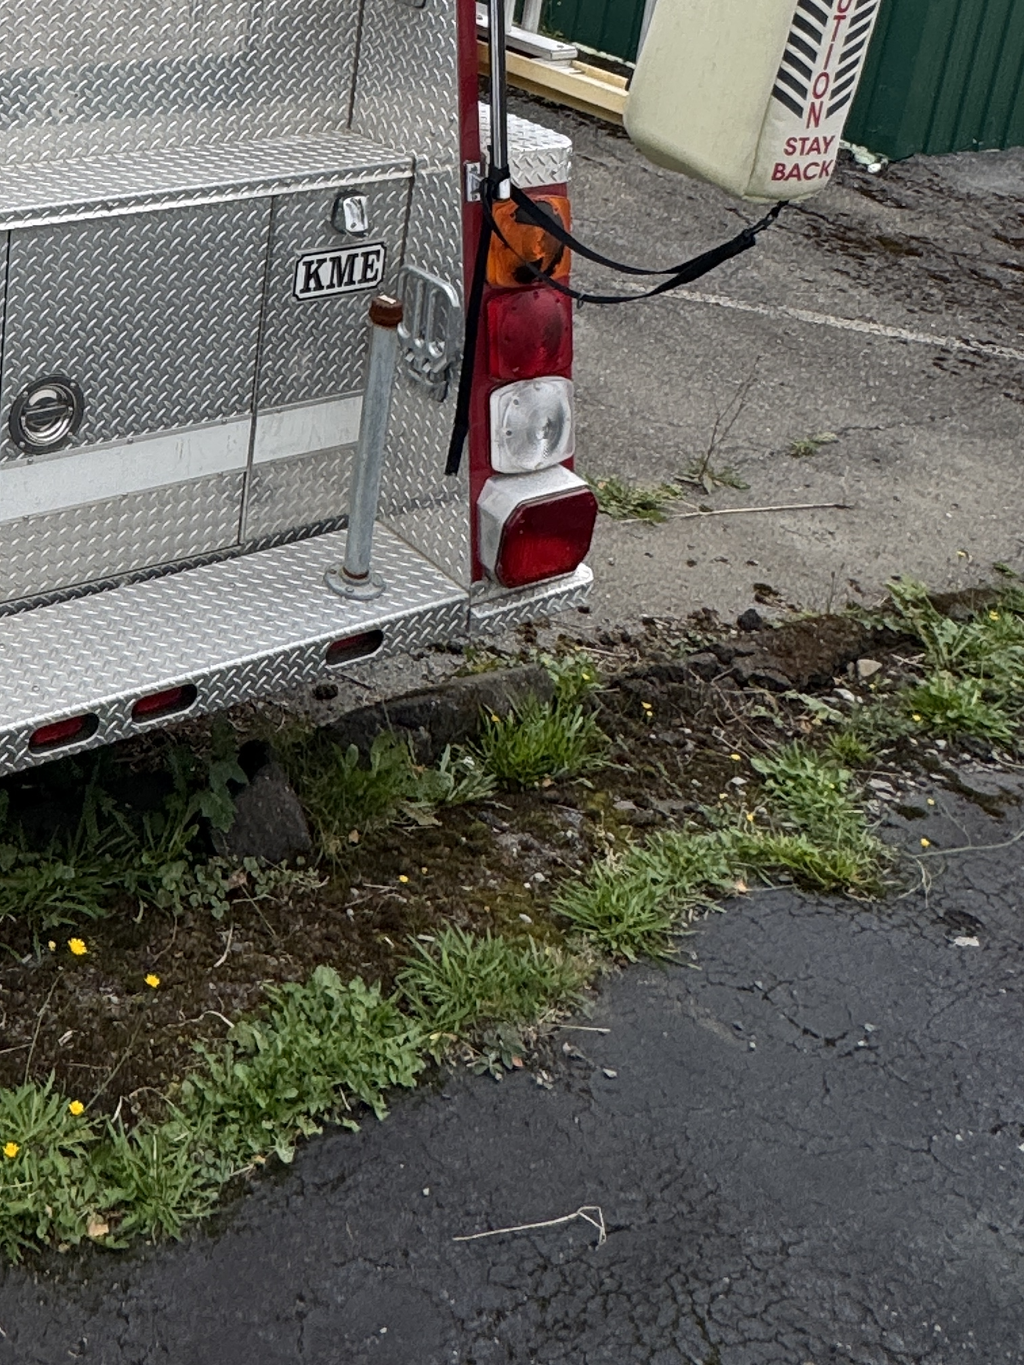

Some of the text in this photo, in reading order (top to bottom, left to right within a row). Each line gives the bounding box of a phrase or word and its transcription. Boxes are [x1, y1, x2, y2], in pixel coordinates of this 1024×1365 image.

[783, 135, 835, 157] STAY
[771, 159, 833, 182] BACK
[299, 249, 381, 294] KME
